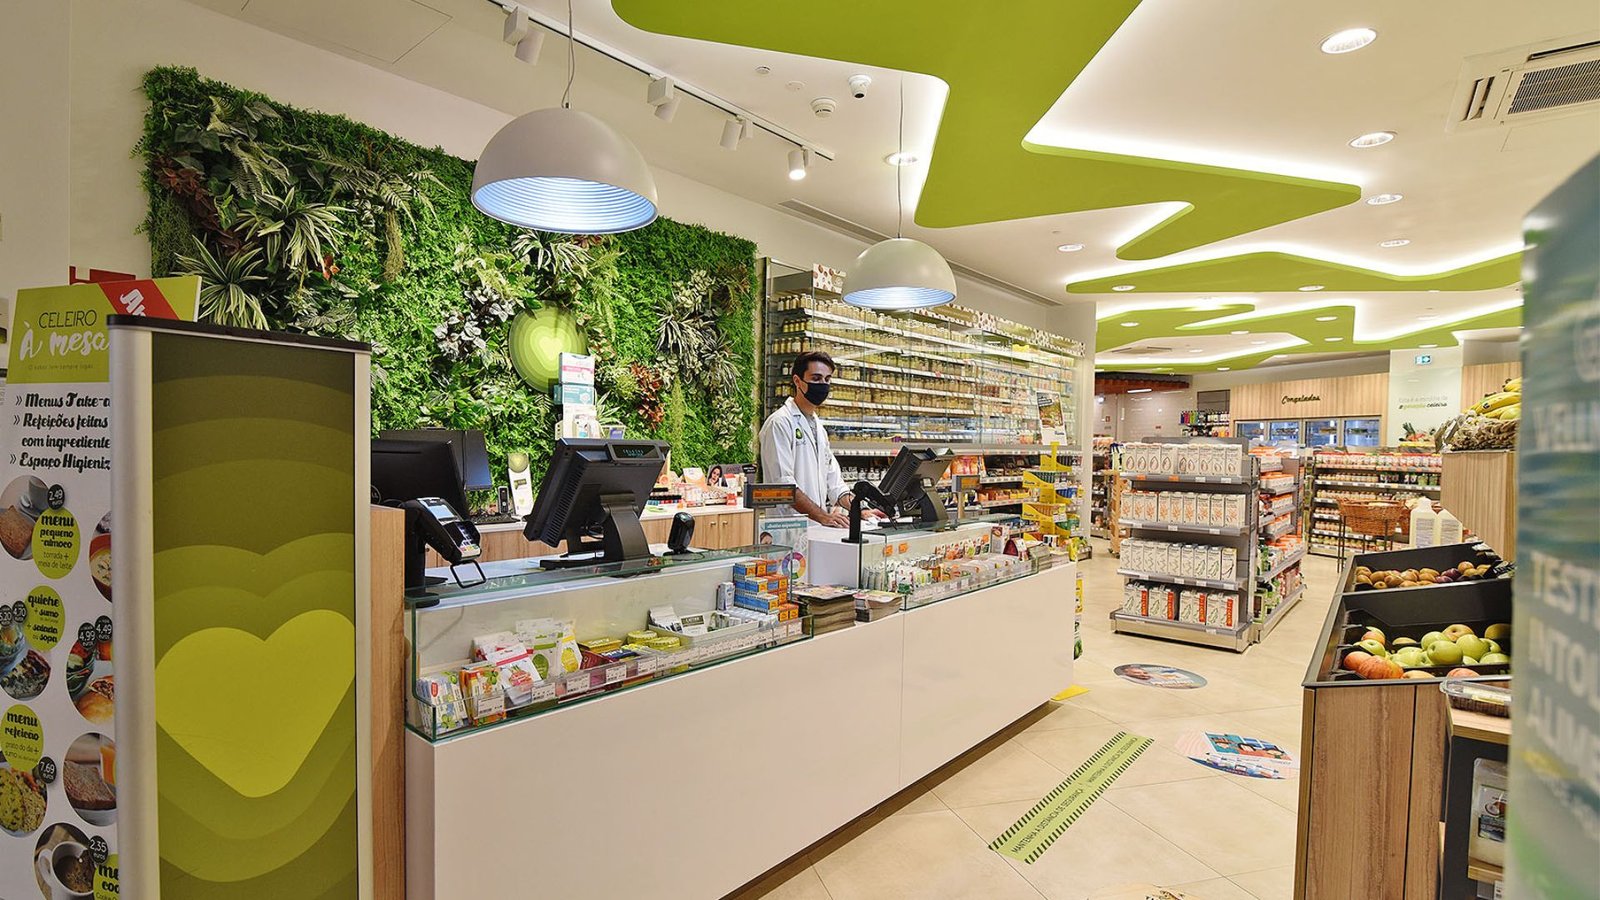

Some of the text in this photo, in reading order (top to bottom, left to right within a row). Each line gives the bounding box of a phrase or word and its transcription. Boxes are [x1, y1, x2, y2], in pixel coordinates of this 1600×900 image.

[39, 309, 97, 329] CELEIRO
[20, 320, 110, 361] À mesa
[25, 392, 111, 407] Menus Take-a
[23, 413, 108, 430] Refeições feitas
[22, 434, 111, 452] com ingrediente
[19, 452, 111, 473] Espaço Higieniz
[41, 515, 75, 526] menu
[40, 528, 74, 539] pequeno
[43, 551, 63, 559] torrada
[28, 594, 59, 607] quiche
[39, 609, 59, 618] sumo
[32, 624, 58, 633] salada
[40, 634, 57, 643] sopa
[7, 712, 38, 727] menu
